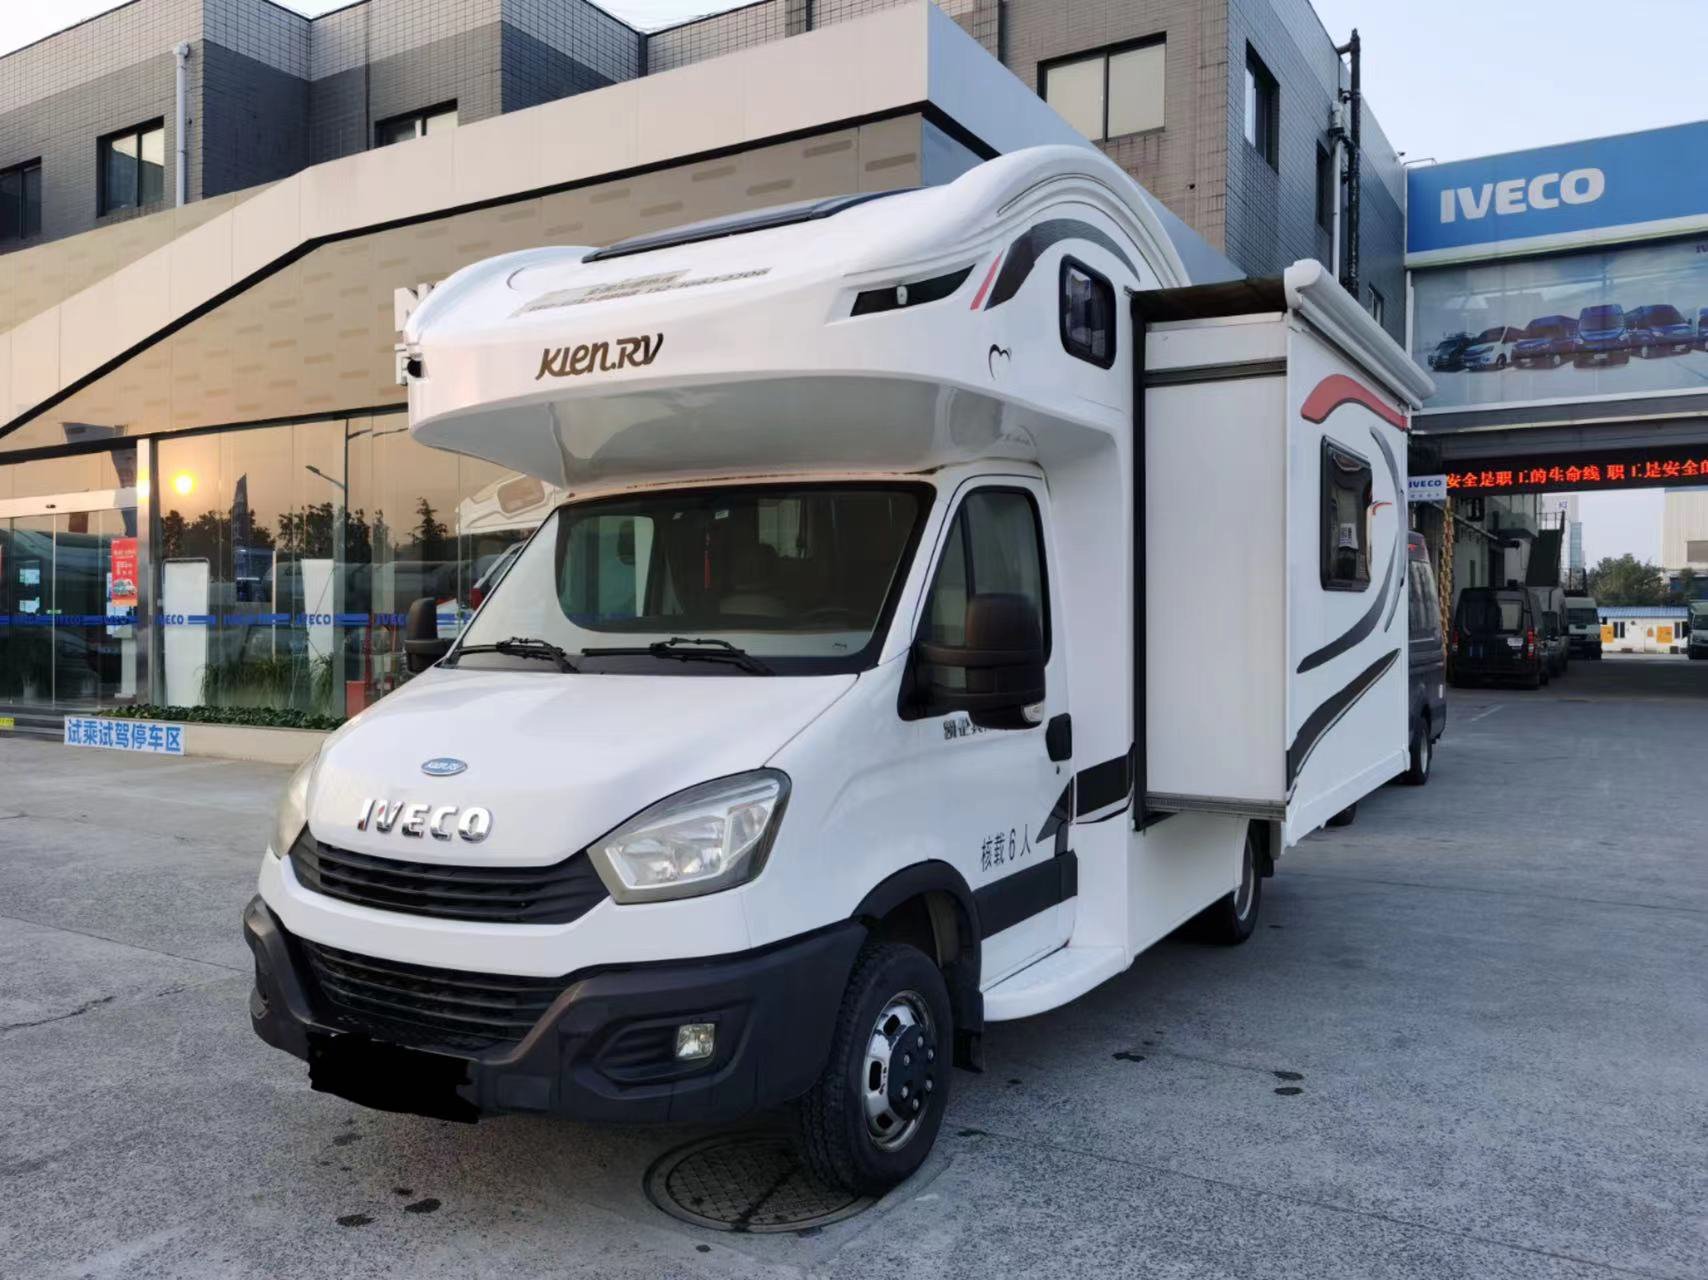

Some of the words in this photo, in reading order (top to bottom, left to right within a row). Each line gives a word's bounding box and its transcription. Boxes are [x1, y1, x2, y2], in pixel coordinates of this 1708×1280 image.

[1440, 168, 1605, 223] IVECO
[1408, 480, 1442, 488] IVECO
[68, 719, 181, 752] 试乘试驾停车区
[357, 799, 493, 843] IVECO
[981, 823, 1031, 873] 核载6人
